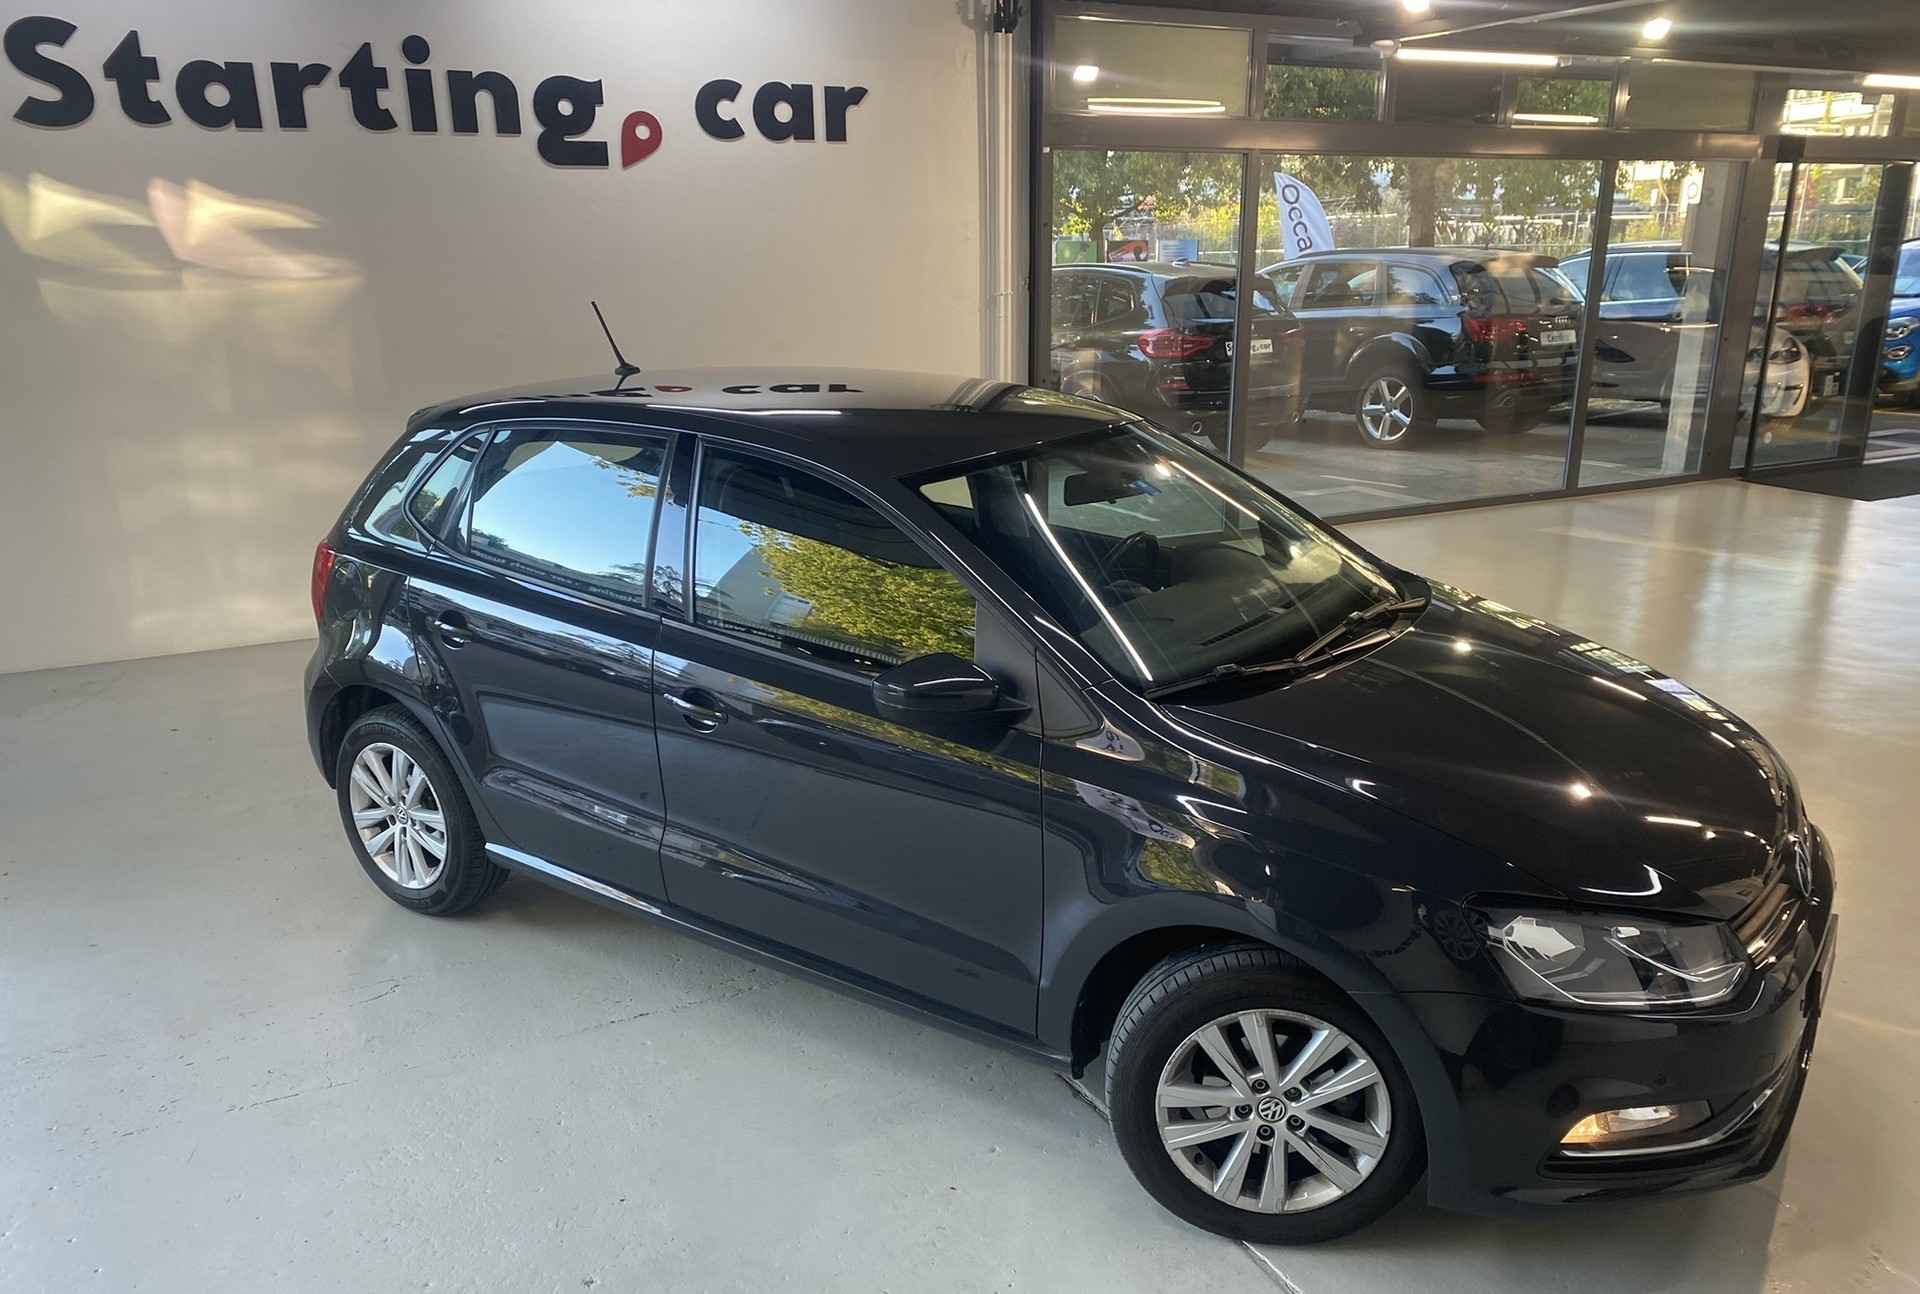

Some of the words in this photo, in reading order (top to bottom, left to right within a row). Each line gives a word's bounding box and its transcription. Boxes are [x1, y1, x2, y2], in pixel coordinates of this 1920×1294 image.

[4, 17, 609, 166] Starting
[696, 80, 868, 141] car
[1282, 184, 1313, 253] Occa
